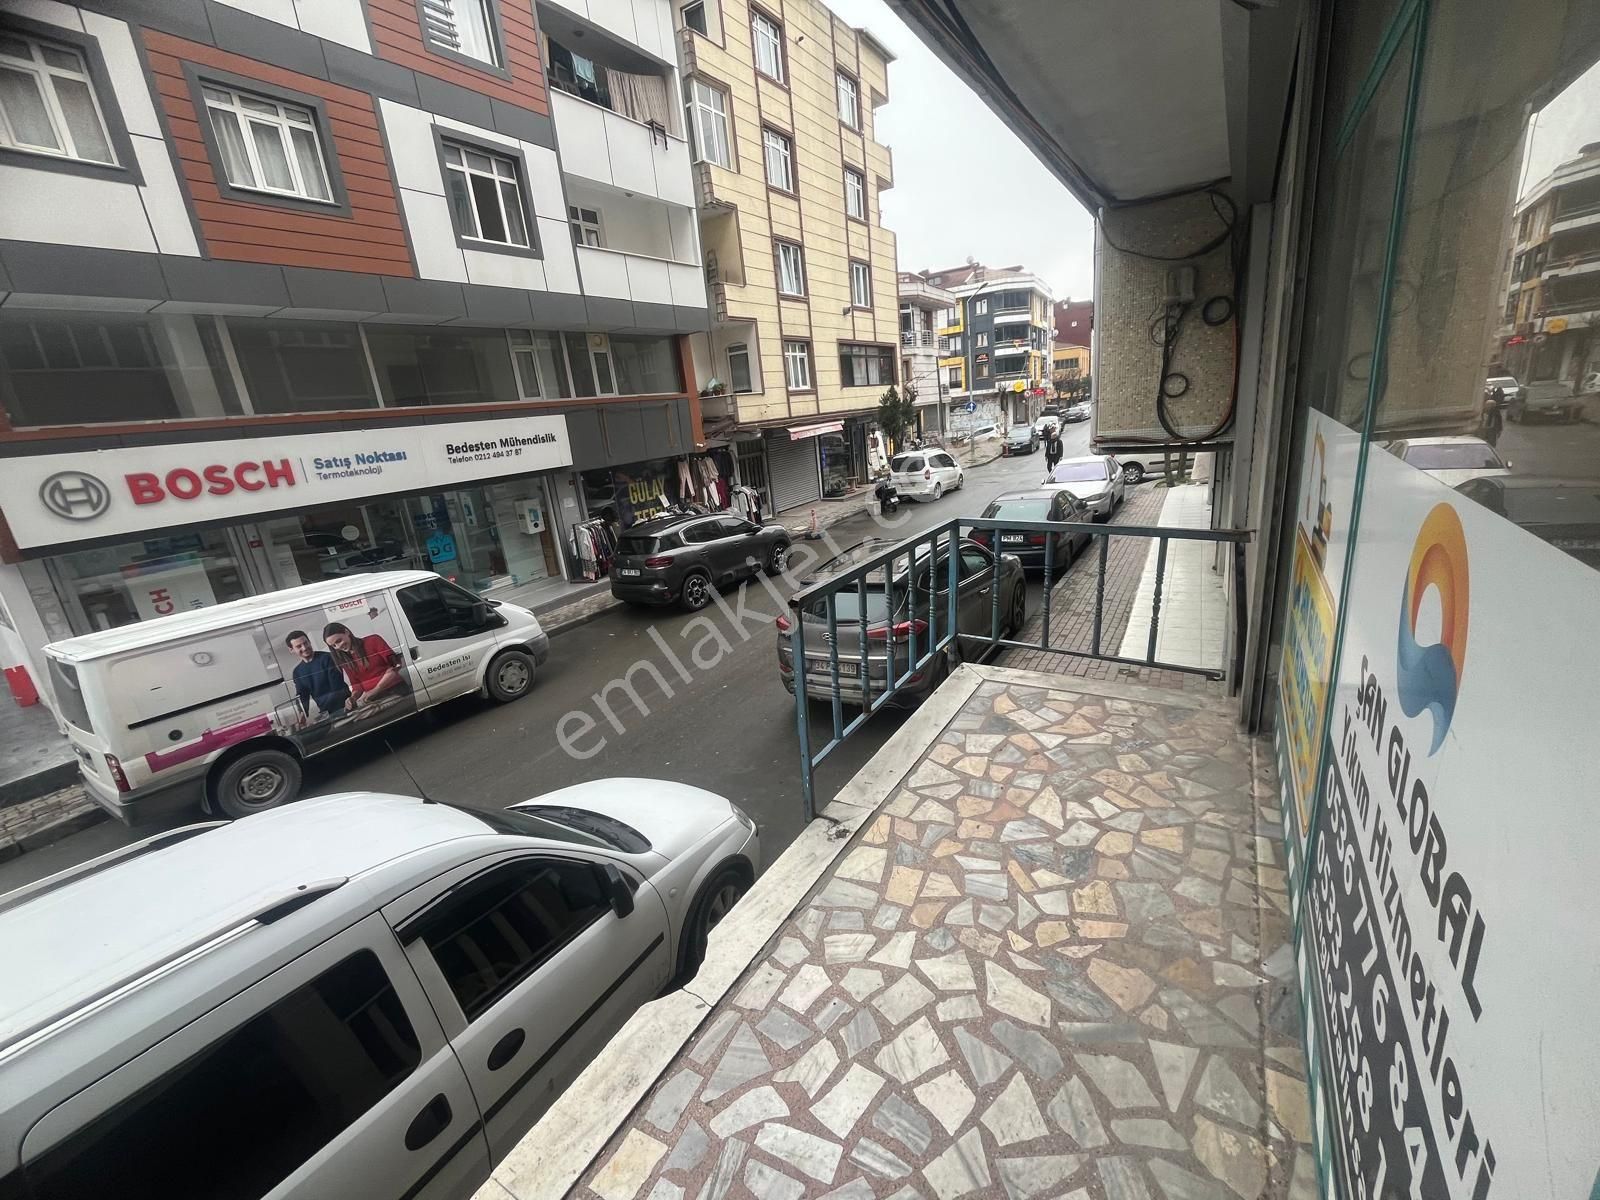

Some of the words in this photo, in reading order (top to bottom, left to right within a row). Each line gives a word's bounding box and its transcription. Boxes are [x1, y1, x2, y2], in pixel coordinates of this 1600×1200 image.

[446, 441, 498, 455] Bedesten
[500, 433, 557, 449] Mühendislik
[313, 456, 352, 469] Satış
[354, 450, 407, 465] Noktası
[448, 455, 474, 464] Telefon
[475, 453, 491, 462] 0212
[124, 458, 296, 505] BOSCH
[316, 465, 383, 480] Termoteknoloji
[339, 598, 363, 610] BOSCH
[427, 658, 461, 674] Bedesten
[1387, 724, 1486, 1024] GLOBAL
[1326, 764, 1356, 896] 0536
[1352, 877, 1390, 1044] 776
[1341, 703, 1370, 832] Yıkım
[1369, 803, 1497, 1200] Hizmetleri
[1317, 830, 1343, 970] 0533
[1340, 961, 1374, 1134] 258
